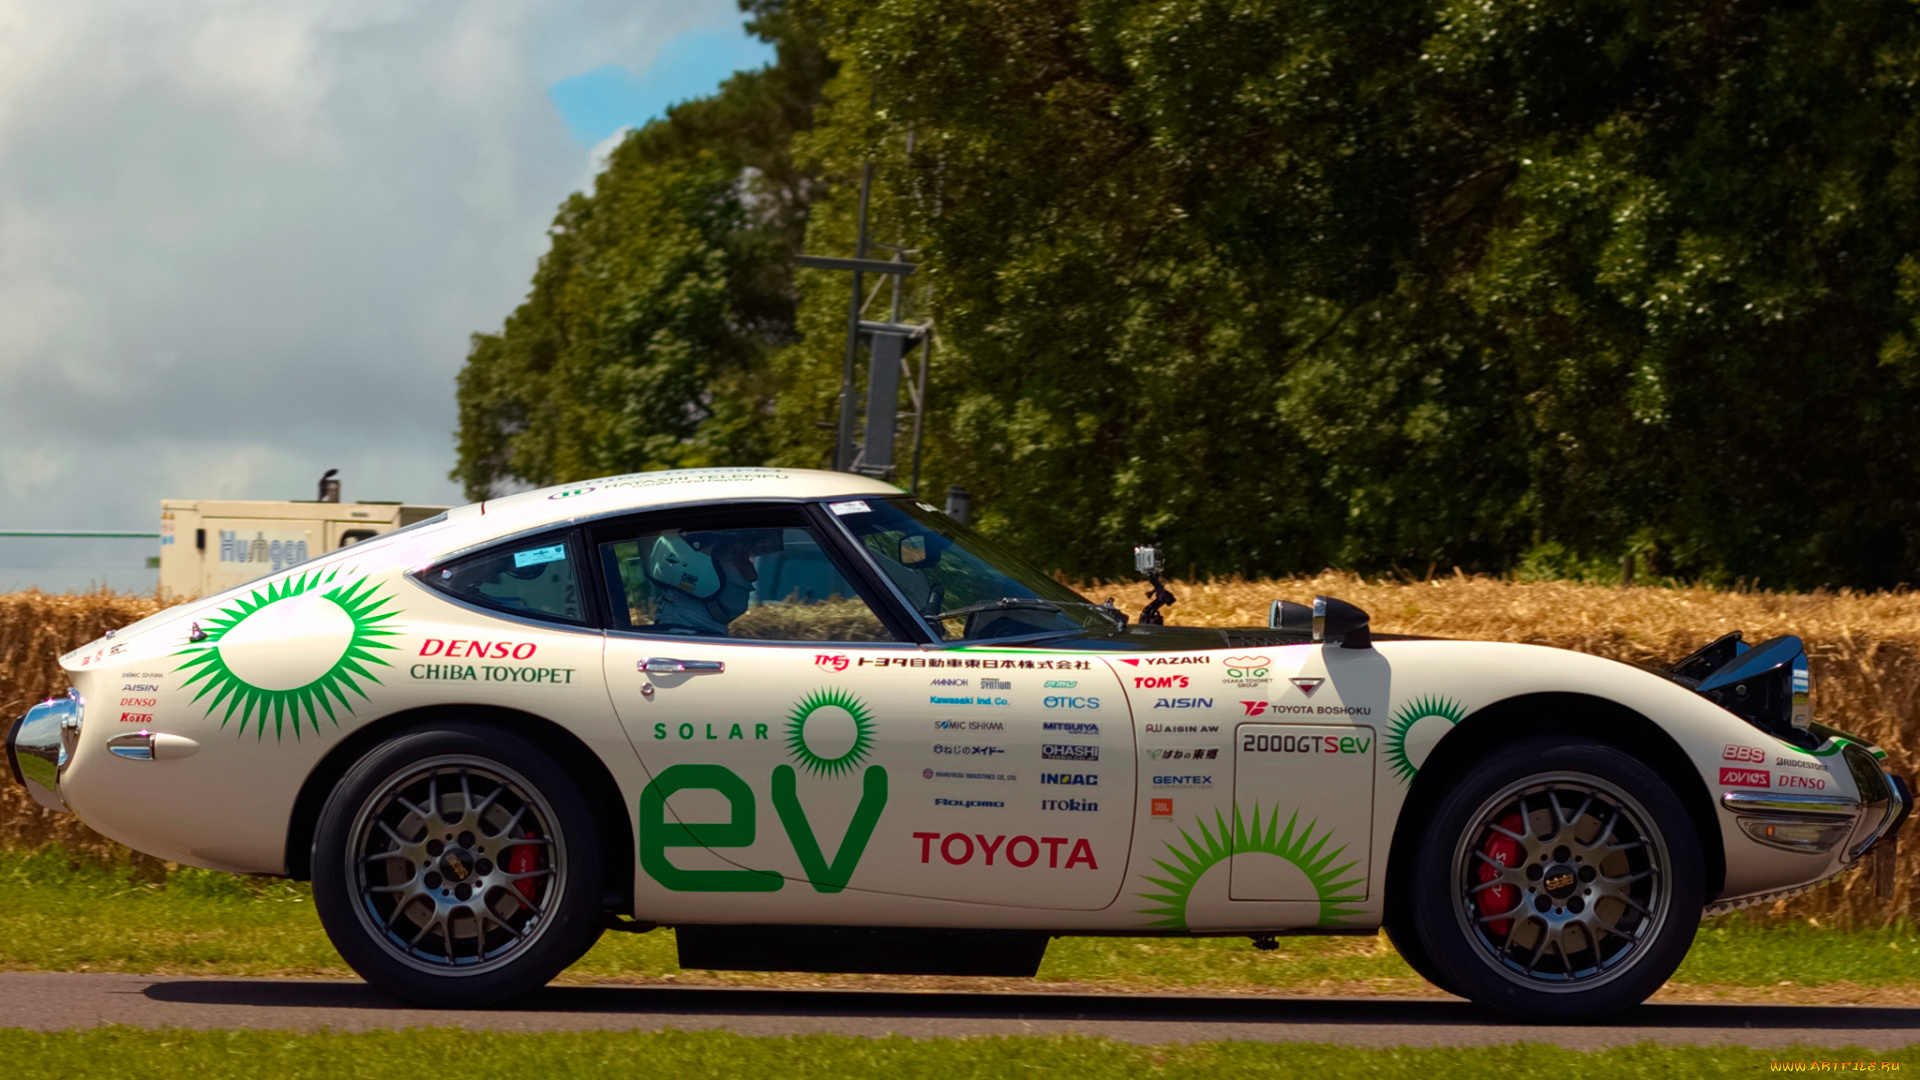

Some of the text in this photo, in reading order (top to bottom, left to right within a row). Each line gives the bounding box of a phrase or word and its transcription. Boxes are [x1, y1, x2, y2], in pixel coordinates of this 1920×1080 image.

[419, 639, 537, 660] DENSO
[857, 657, 1092, 670] トヨタ自動車東日本株式会社
[1145, 656, 1210, 665] YAZAKI
[481, 666, 576, 684] TOYOPET
[121, 684, 159, 692] AISIN
[1134, 675, 1189, 689] TOM'S
[120, 698, 156, 707] DENSO
[930, 696, 1010, 705] Kawasaki Ind. Co.
[1043, 696, 1100, 709] OTICS
[1154, 698, 1213, 709] AISIN
[1272, 705, 1371, 716] TOYOTA BOSHOKU
[654, 722, 768, 740] SOLAR
[1043, 722, 1099, 731] MITSUIYA
[1043, 745, 1098, 757] OHASHI
[1723, 744, 1765, 763] BBS
[1776, 757, 1828, 772] BRIDGESTONE
[1041, 773, 1098, 786] INOAC
[1152, 776, 1212, 784] GENTEX
[1778, 775, 1825, 790] DENSO
[640, 764, 889, 893] ev
[913, 832, 1098, 870] TOYOTA
